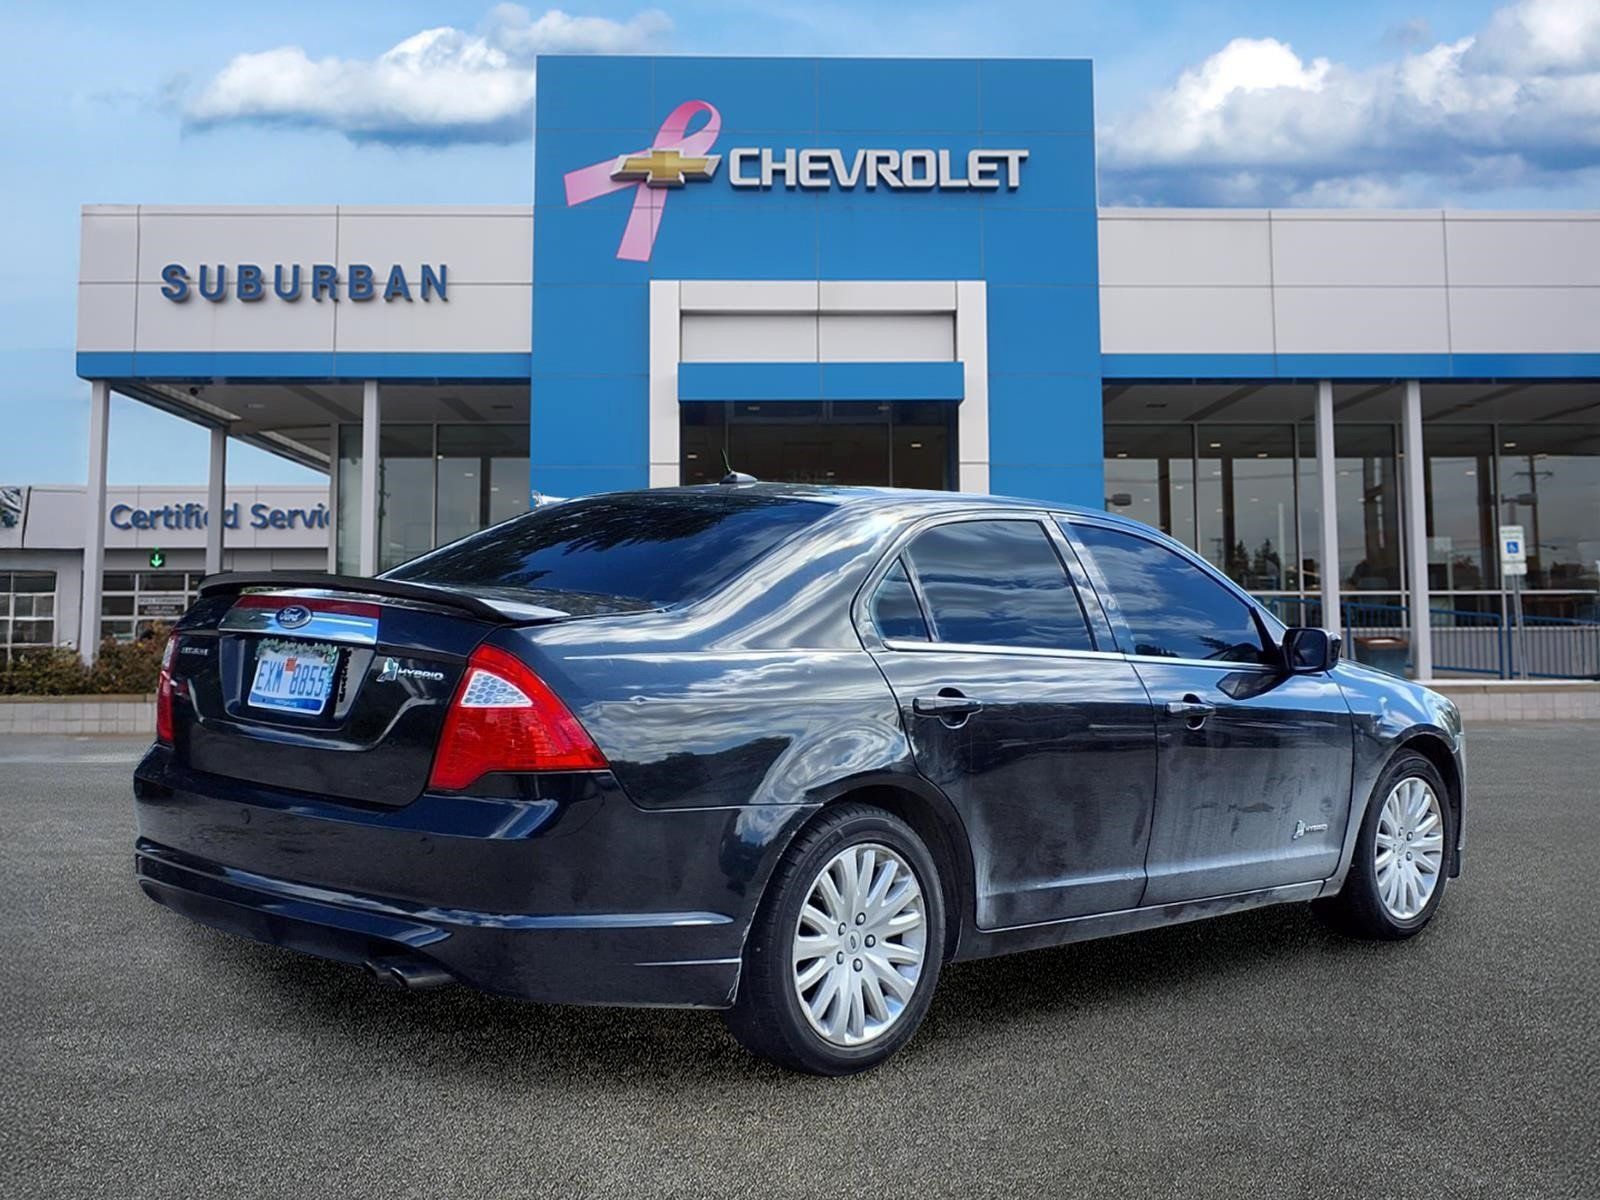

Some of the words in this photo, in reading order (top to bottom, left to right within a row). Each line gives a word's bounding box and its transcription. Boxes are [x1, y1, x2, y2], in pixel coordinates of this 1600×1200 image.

[729, 147, 1029, 190] CHEVROLET
[161, 264, 450, 302] SUBURBAN
[255, 661, 285, 694] EXM
[289, 663, 328, 697] 8855
